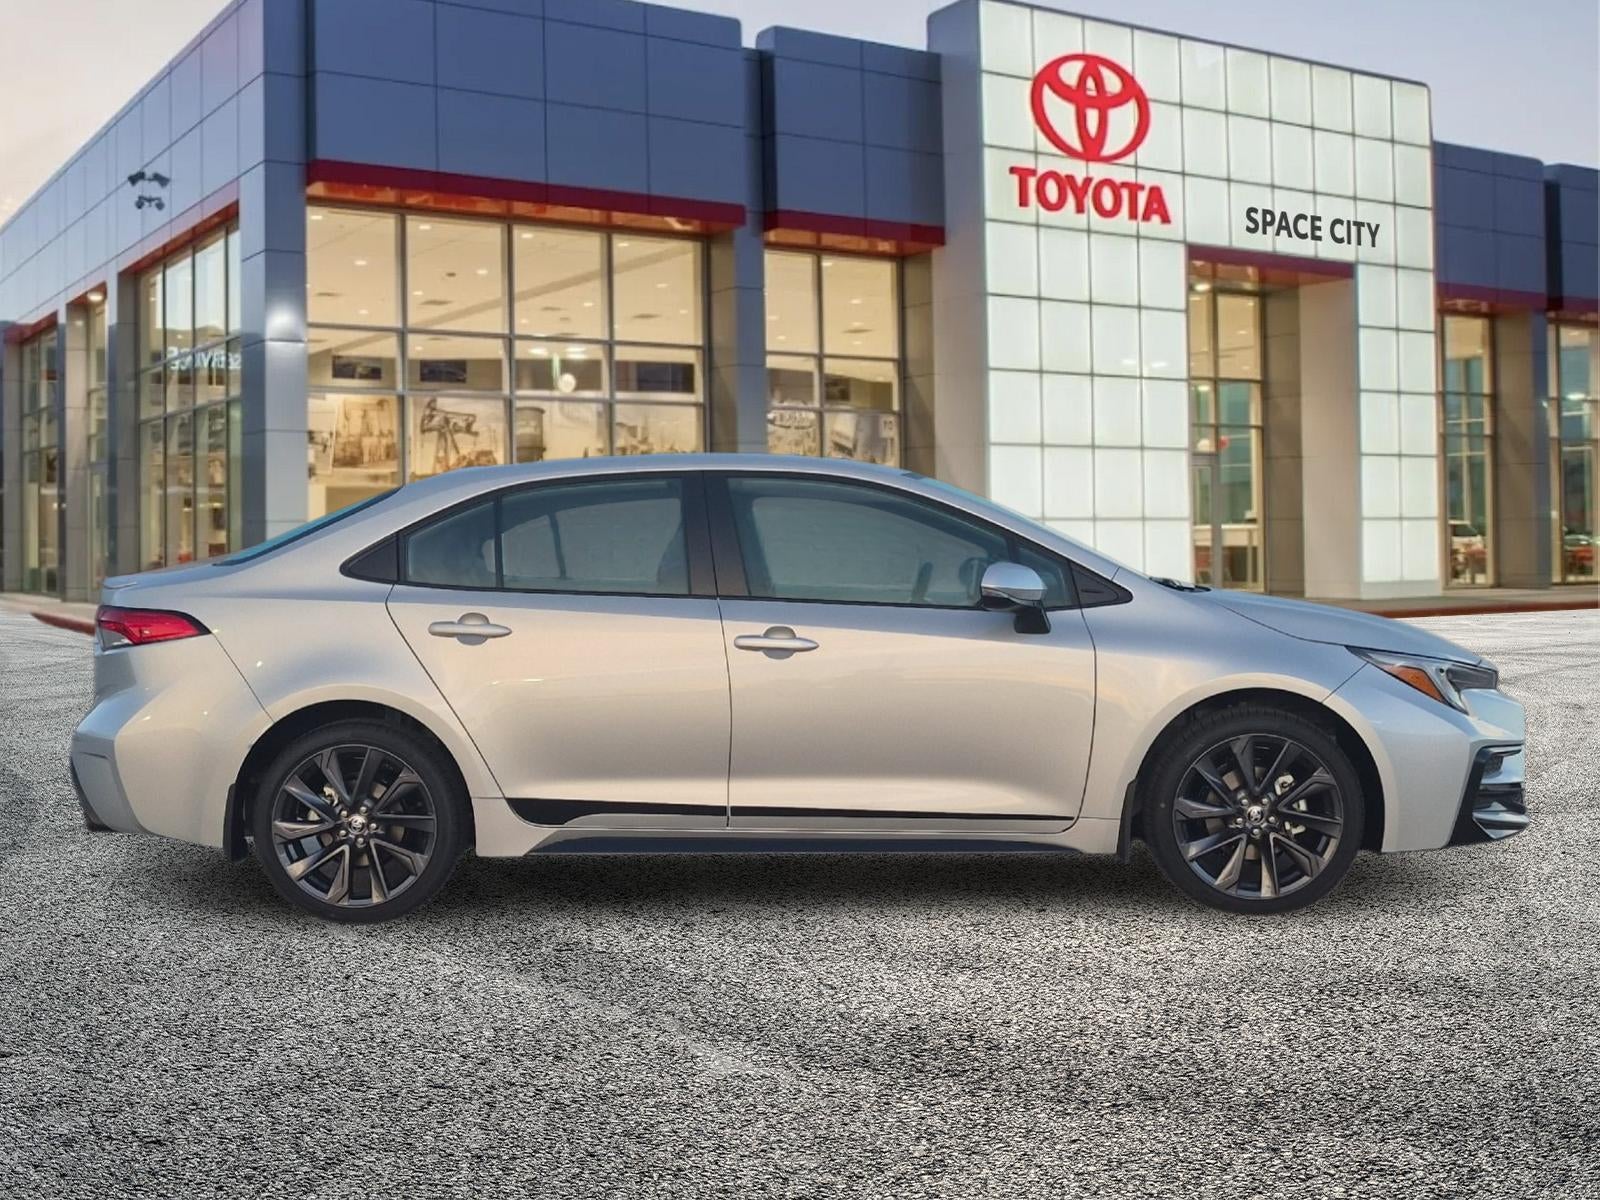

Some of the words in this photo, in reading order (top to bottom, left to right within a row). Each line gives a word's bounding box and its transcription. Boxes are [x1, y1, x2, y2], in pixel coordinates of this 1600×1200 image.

[1009, 166, 1171, 224] TOYOTA
[1245, 207, 1322, 241] SPACE
[1329, 218, 1380, 248] CITY
